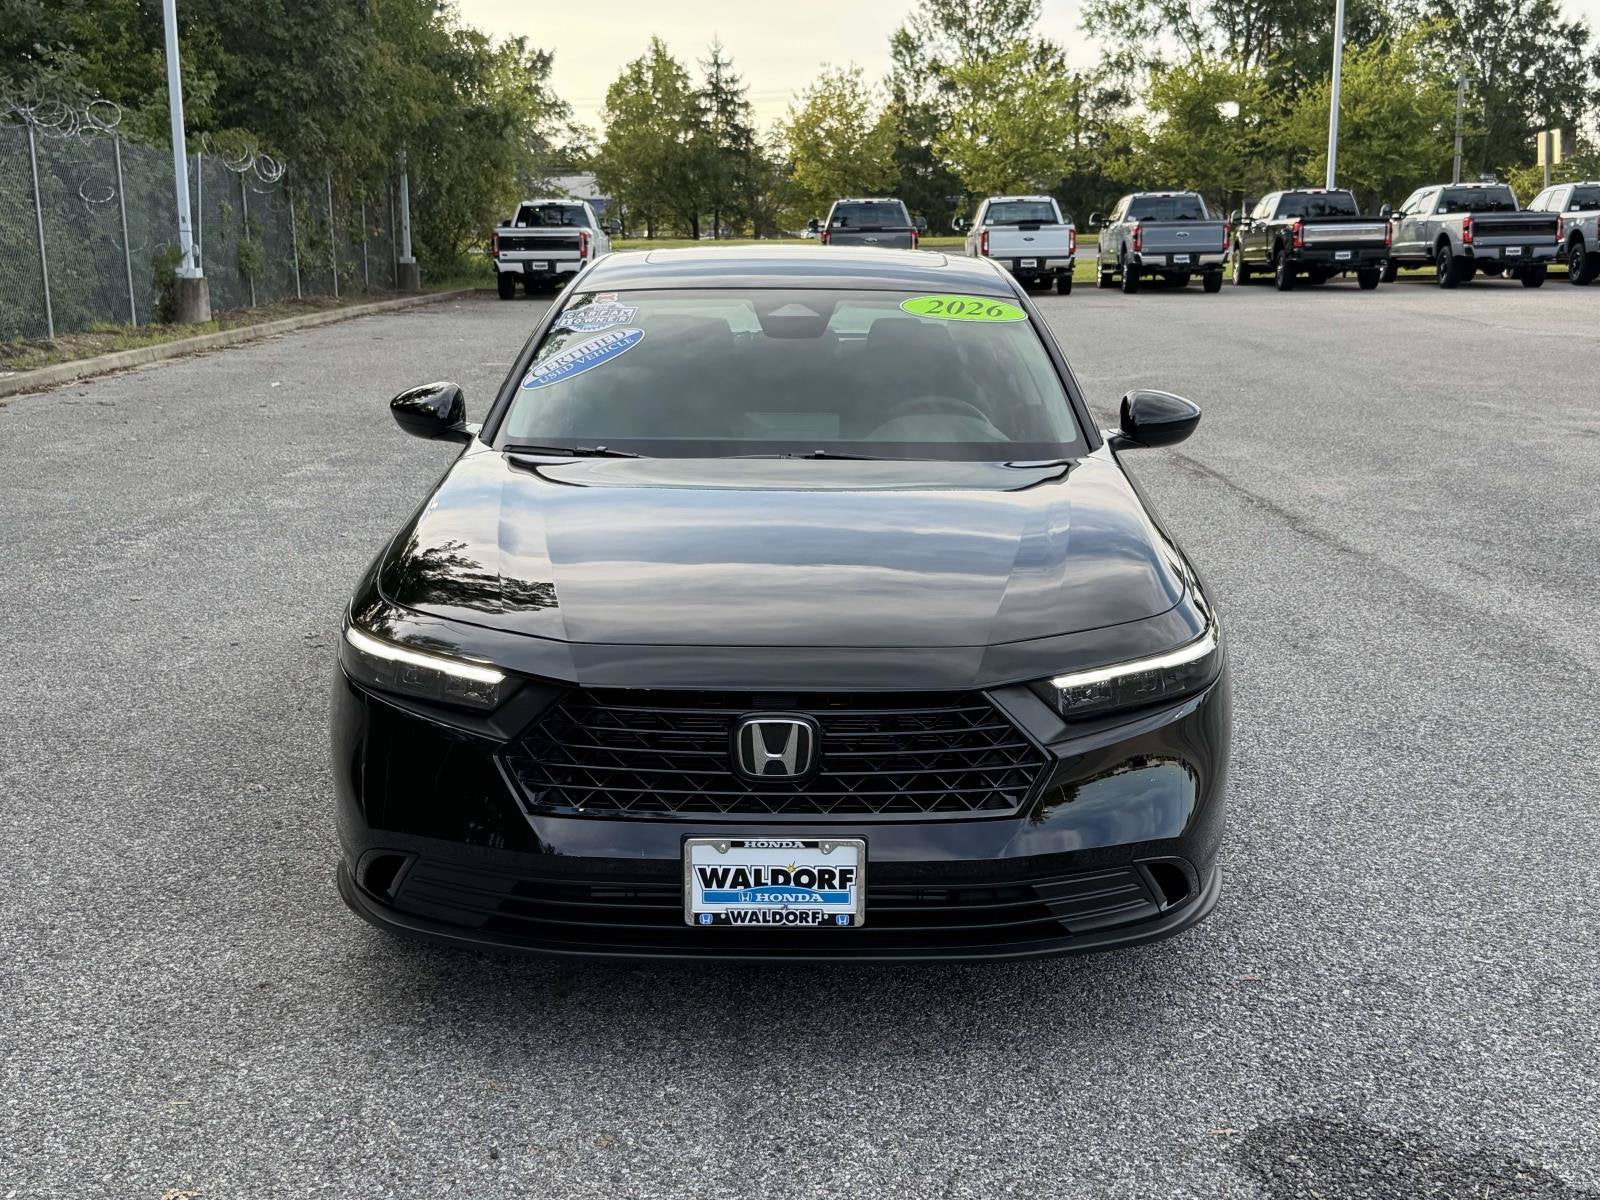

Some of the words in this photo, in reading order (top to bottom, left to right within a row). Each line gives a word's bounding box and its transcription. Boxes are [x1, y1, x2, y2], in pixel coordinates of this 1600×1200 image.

[566, 309, 631, 319] CARFAX
[925, 300, 1003, 317] 2026
[532, 331, 627, 377] CERTIFIED
[539, 363, 574, 383] USED
[577, 337, 634, 364] VEHICLE
[697, 867, 854, 890] WALDORF
[756, 893, 824, 902] HONDA
[729, 910, 821, 924] WALDORF
